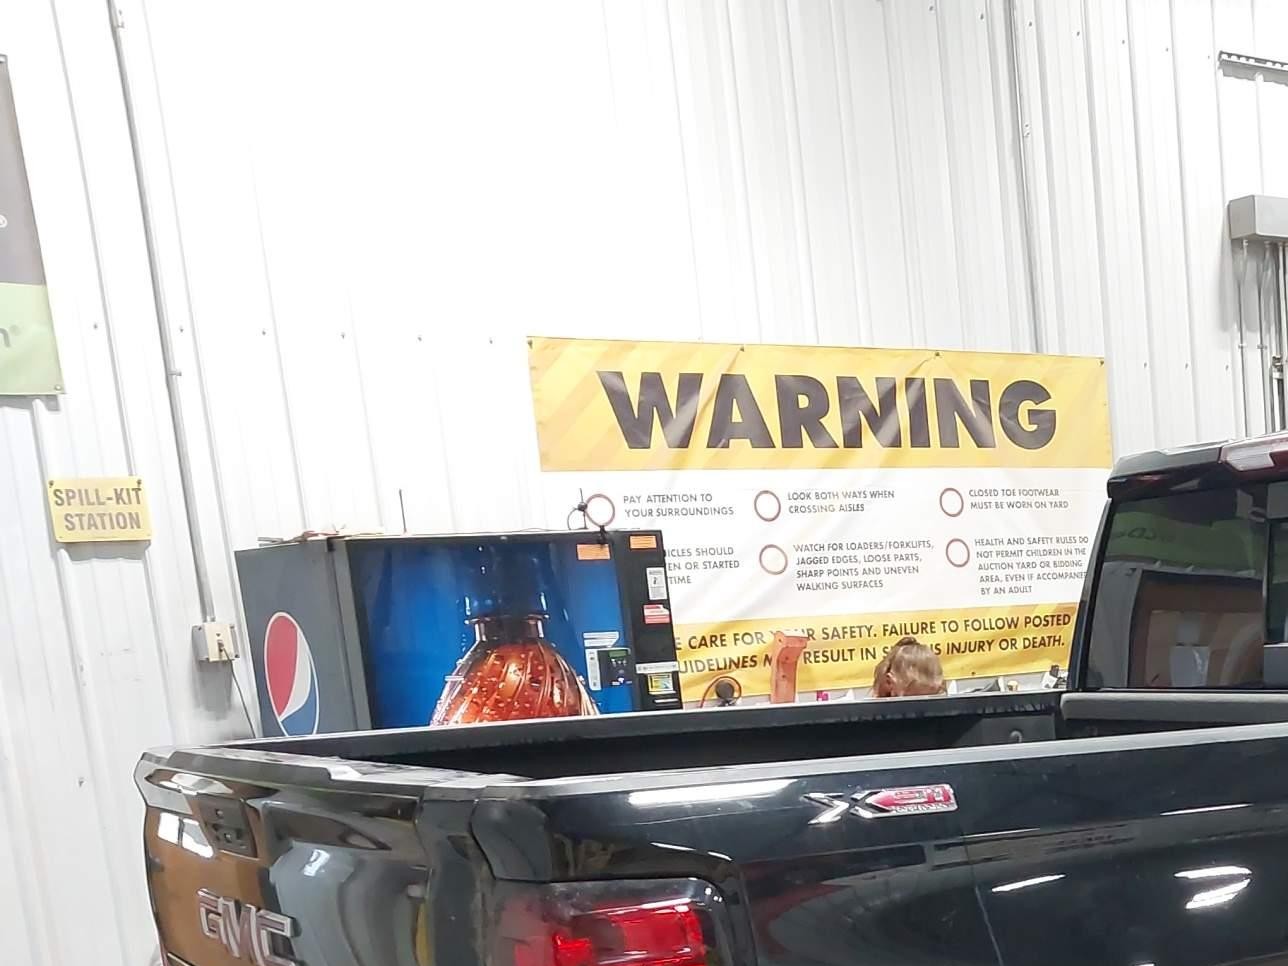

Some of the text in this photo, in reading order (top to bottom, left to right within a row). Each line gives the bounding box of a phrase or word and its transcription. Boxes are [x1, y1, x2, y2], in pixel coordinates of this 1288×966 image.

[596, 371, 1057, 450] WARNING
[53, 488, 142, 506] SPILL-KIT
[623, 493, 713, 504] PAY ATTENTION TO
[787, 490, 895, 501] LOOK BOTH WAYS WHEN
[969, 488, 1059, 497] CLOSED TOE FOOTWEAR
[788, 503, 865, 514] CROSSING AISLES
[970, 500, 1069, 510] MUST BE WORN ON YARD
[625, 506, 734, 518] YOUR SURROUNDINGS
[64, 512, 141, 531] STATION
[793, 539, 934, 552] WATCH FOR LOADERS/FORKLIFTS,
[974, 535, 1089, 547] HEALTH AND SAFETY RULES DO
[667, 546, 734, 558] ICLES SHOULD
[976, 547, 1087, 559] NOT PERMIT CHILDREN IN THE
[684, 561, 700, 571] OR
[702, 560, 740, 570] STARTED
[796, 553, 923, 566] JAGGED EDGES, LOOSE PARTS,
[978, 559, 1083, 571] AUCTION YARD OR BIDDING
[796, 566, 919, 579] SHARP POINTS AND UNEVEN
[1005, 573, 1026, 582] EVEN
[1027, 573, 1035, 581] IF
[668, 575, 691, 585] TIME
[796, 579, 884, 591] WALKING SURFACES
[980, 585, 1033, 595] BY AN ADULT
[687, 633, 727, 650] CARE
[733, 631, 766, 647] FOR
[822, 624, 877, 641] SAFETY.
[882, 621, 936, 637] FAILURE
[941, 619, 959, 633] TO
[964, 616, 1020, 632] FOLLOW
[1024, 613, 1071, 629] POSTED
[679, 654, 758, 674] UIDELINES
[803, 648, 856, 665] RESULT
[860, 647, 877, 661] IN
[946, 639, 996, 655] INJURY
[999, 637, 1018, 651] OR
[1022, 635, 1065, 650] DEATH.
